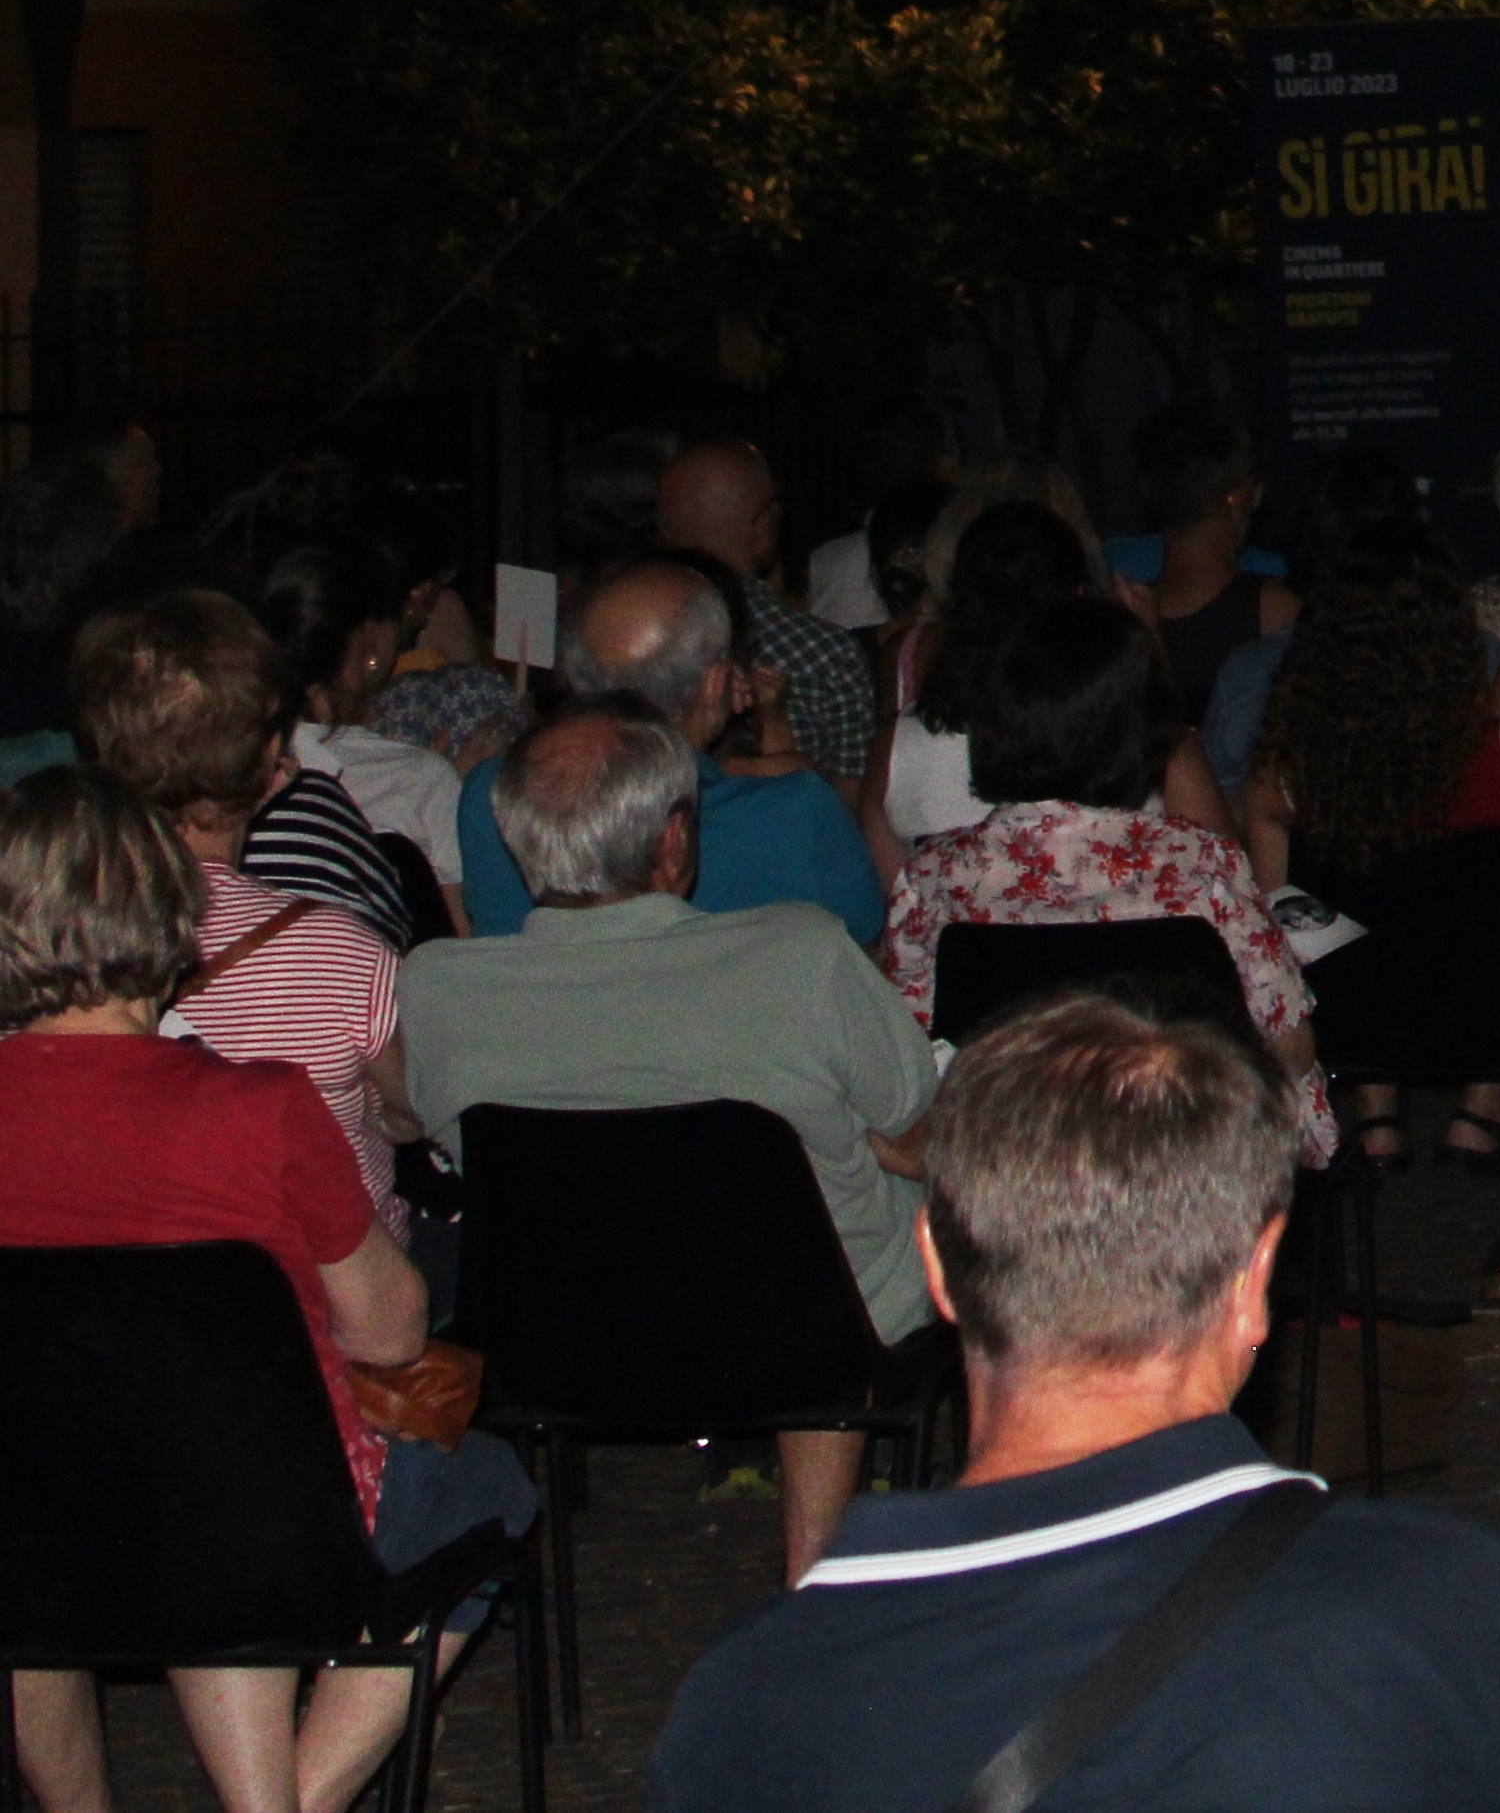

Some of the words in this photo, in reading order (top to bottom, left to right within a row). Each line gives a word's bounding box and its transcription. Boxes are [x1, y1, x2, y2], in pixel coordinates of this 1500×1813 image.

[1309, 51, 1335, 73] 23
[1274, 76, 1346, 98] LUGLIO
[1349, 73, 1399, 95] 2023
